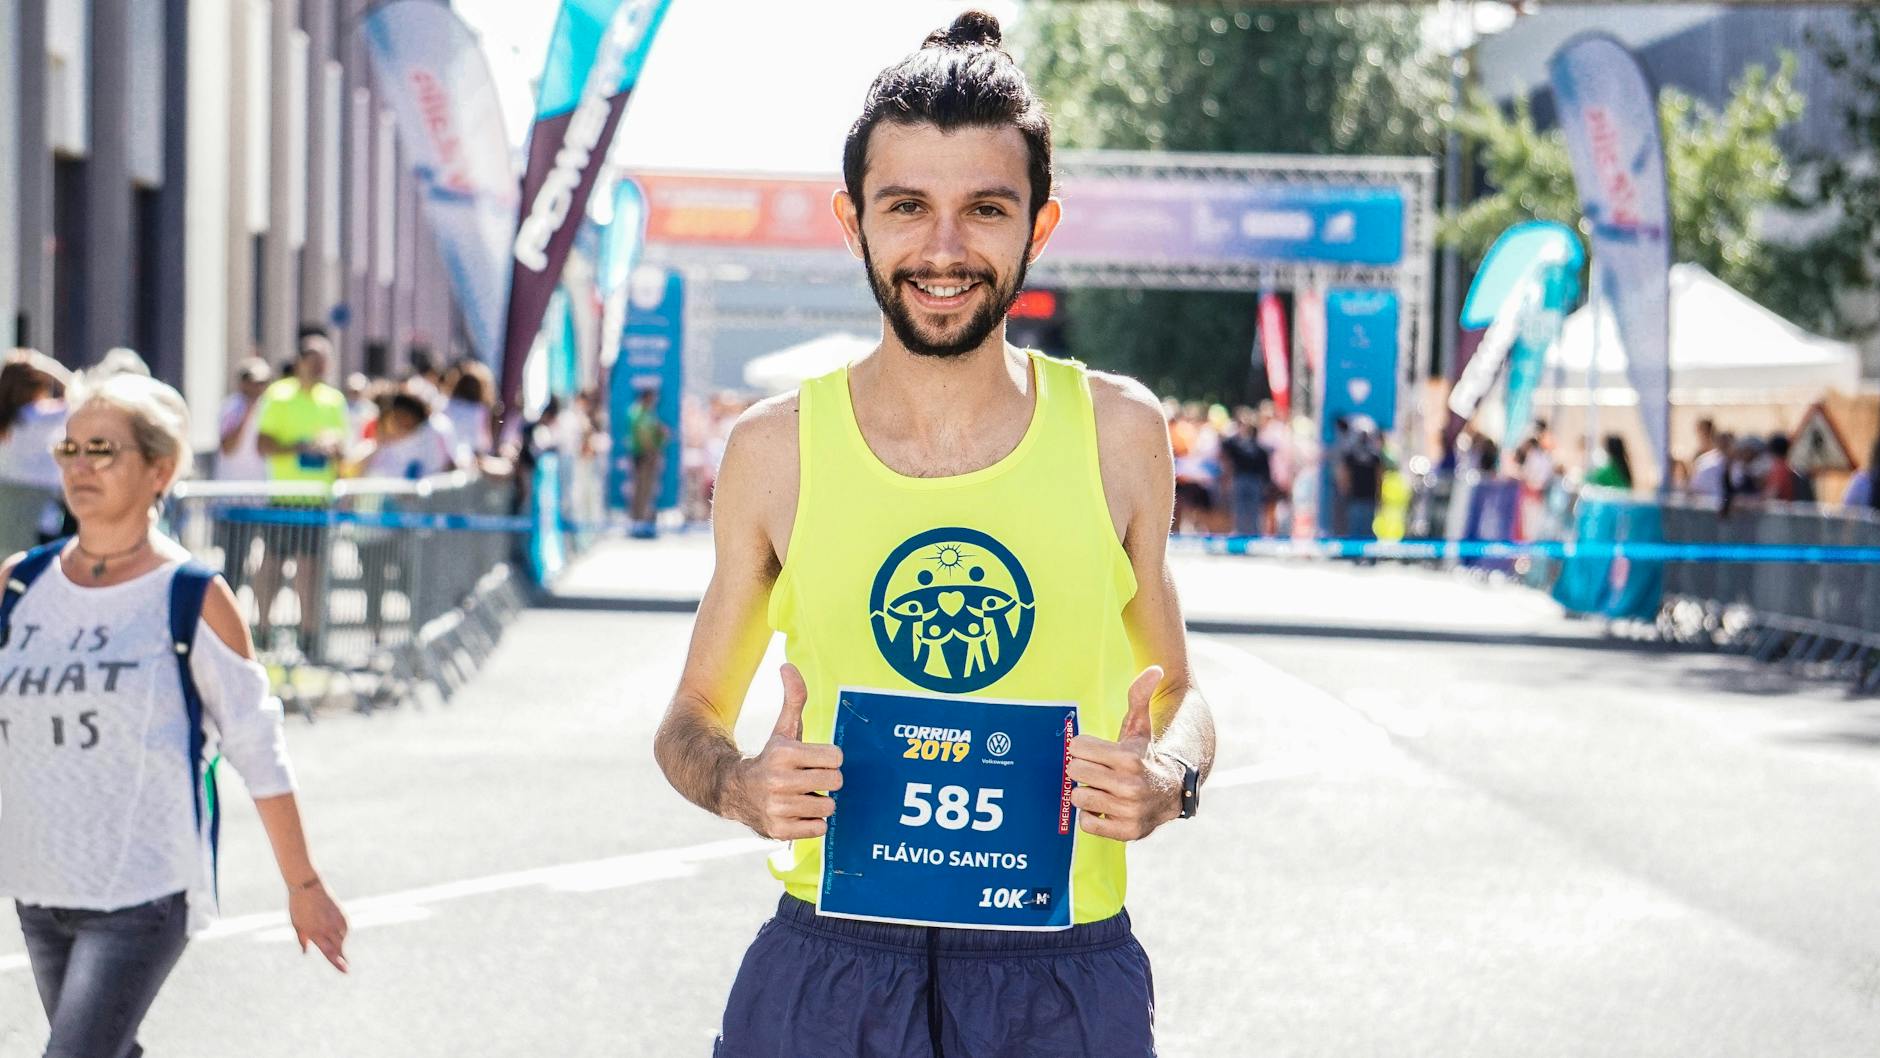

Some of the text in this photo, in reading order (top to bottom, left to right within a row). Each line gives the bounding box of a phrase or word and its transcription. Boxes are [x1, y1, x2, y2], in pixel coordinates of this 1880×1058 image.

[69, 625, 109, 652] IS
[0, 661, 139, 696] HAT
[51, 710, 99, 750] IS
[893, 724, 972, 743] CORRIDA
[903, 738, 970, 763] 2019
[981, 758, 1014, 767] Volkswagen
[899, 782, 1004, 832] 585
[872, 842, 1028, 870] FLÁVIO SANTOS
[979, 887, 1027, 909] 10K
